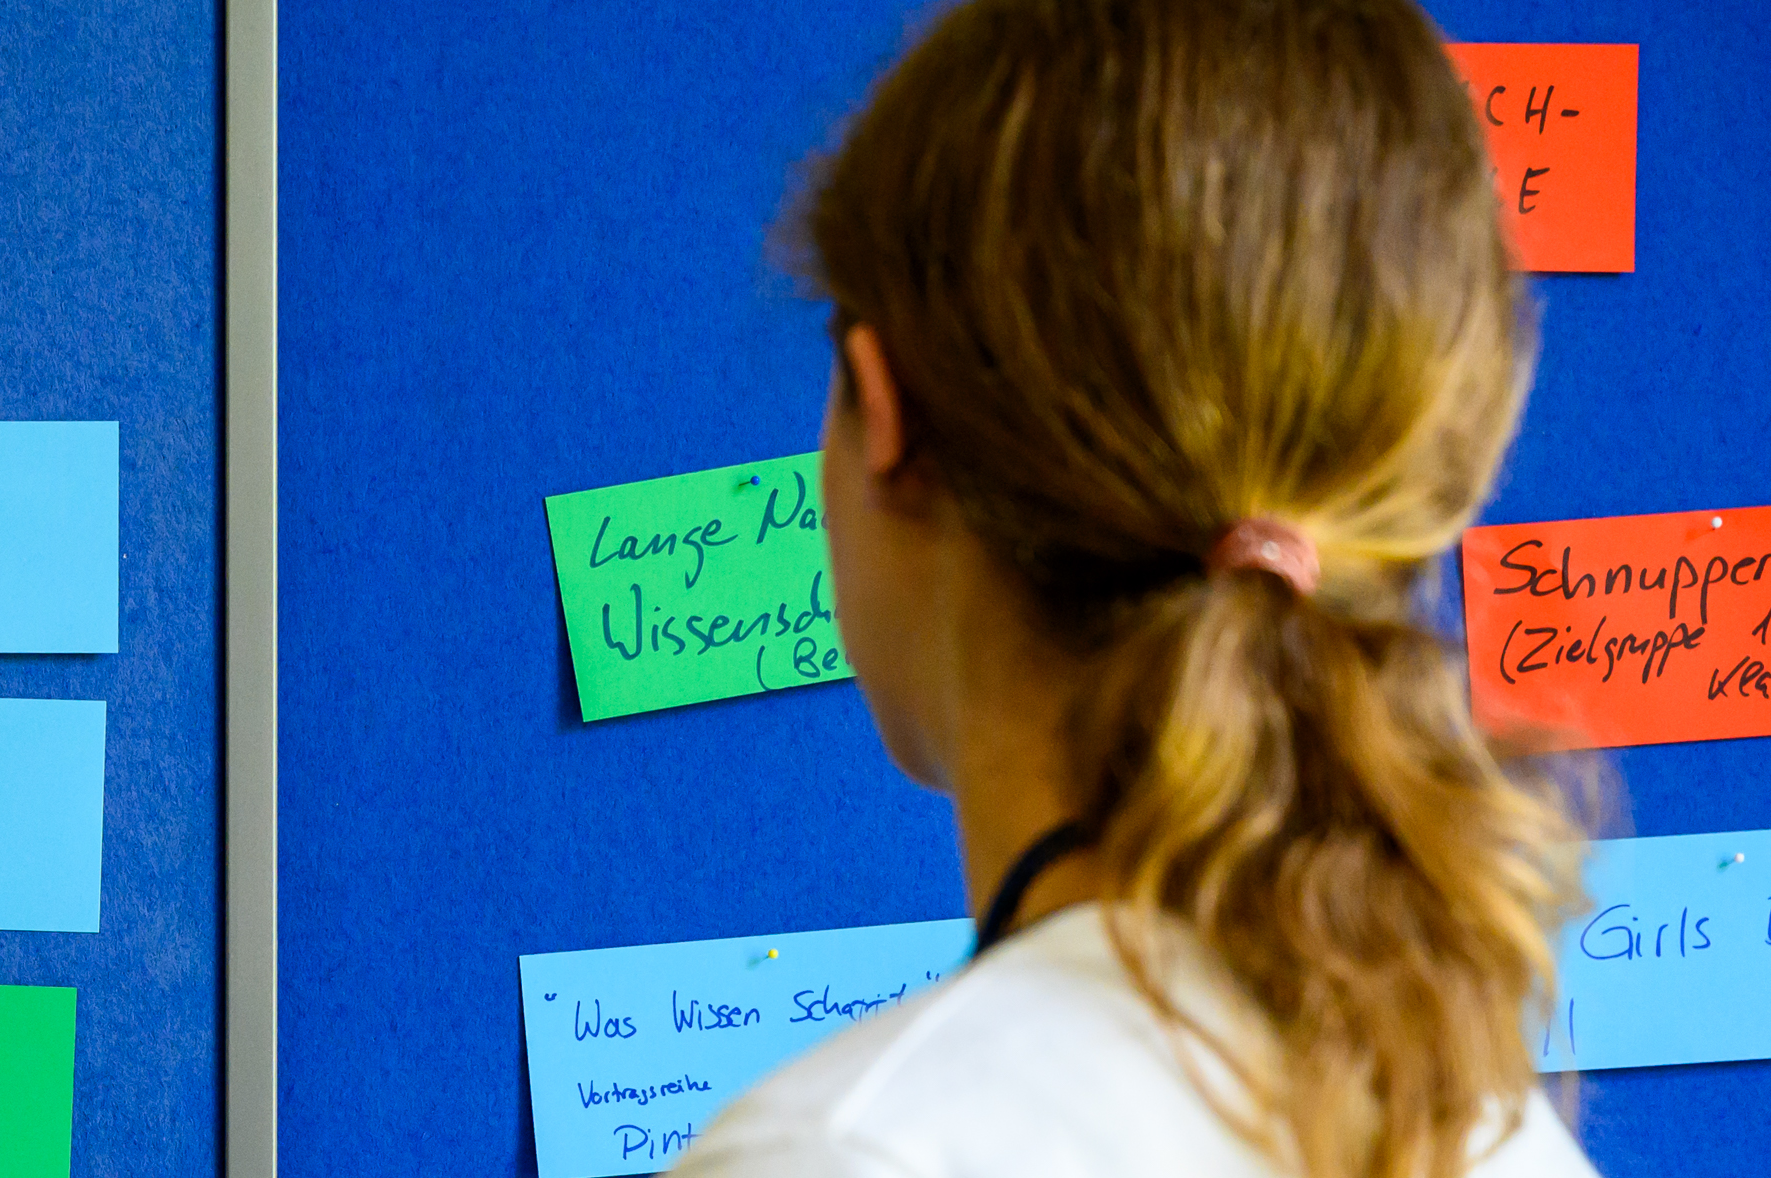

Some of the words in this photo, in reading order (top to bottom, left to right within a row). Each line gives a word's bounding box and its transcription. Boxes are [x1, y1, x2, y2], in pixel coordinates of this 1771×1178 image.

[588, 515, 740, 590] Lange
[601, 569, 841, 662] Wissensch
[756, 635, 851, 691] (Be
[1579, 903, 1711, 961] Girls
[672, 989, 761, 1034] Wissen
